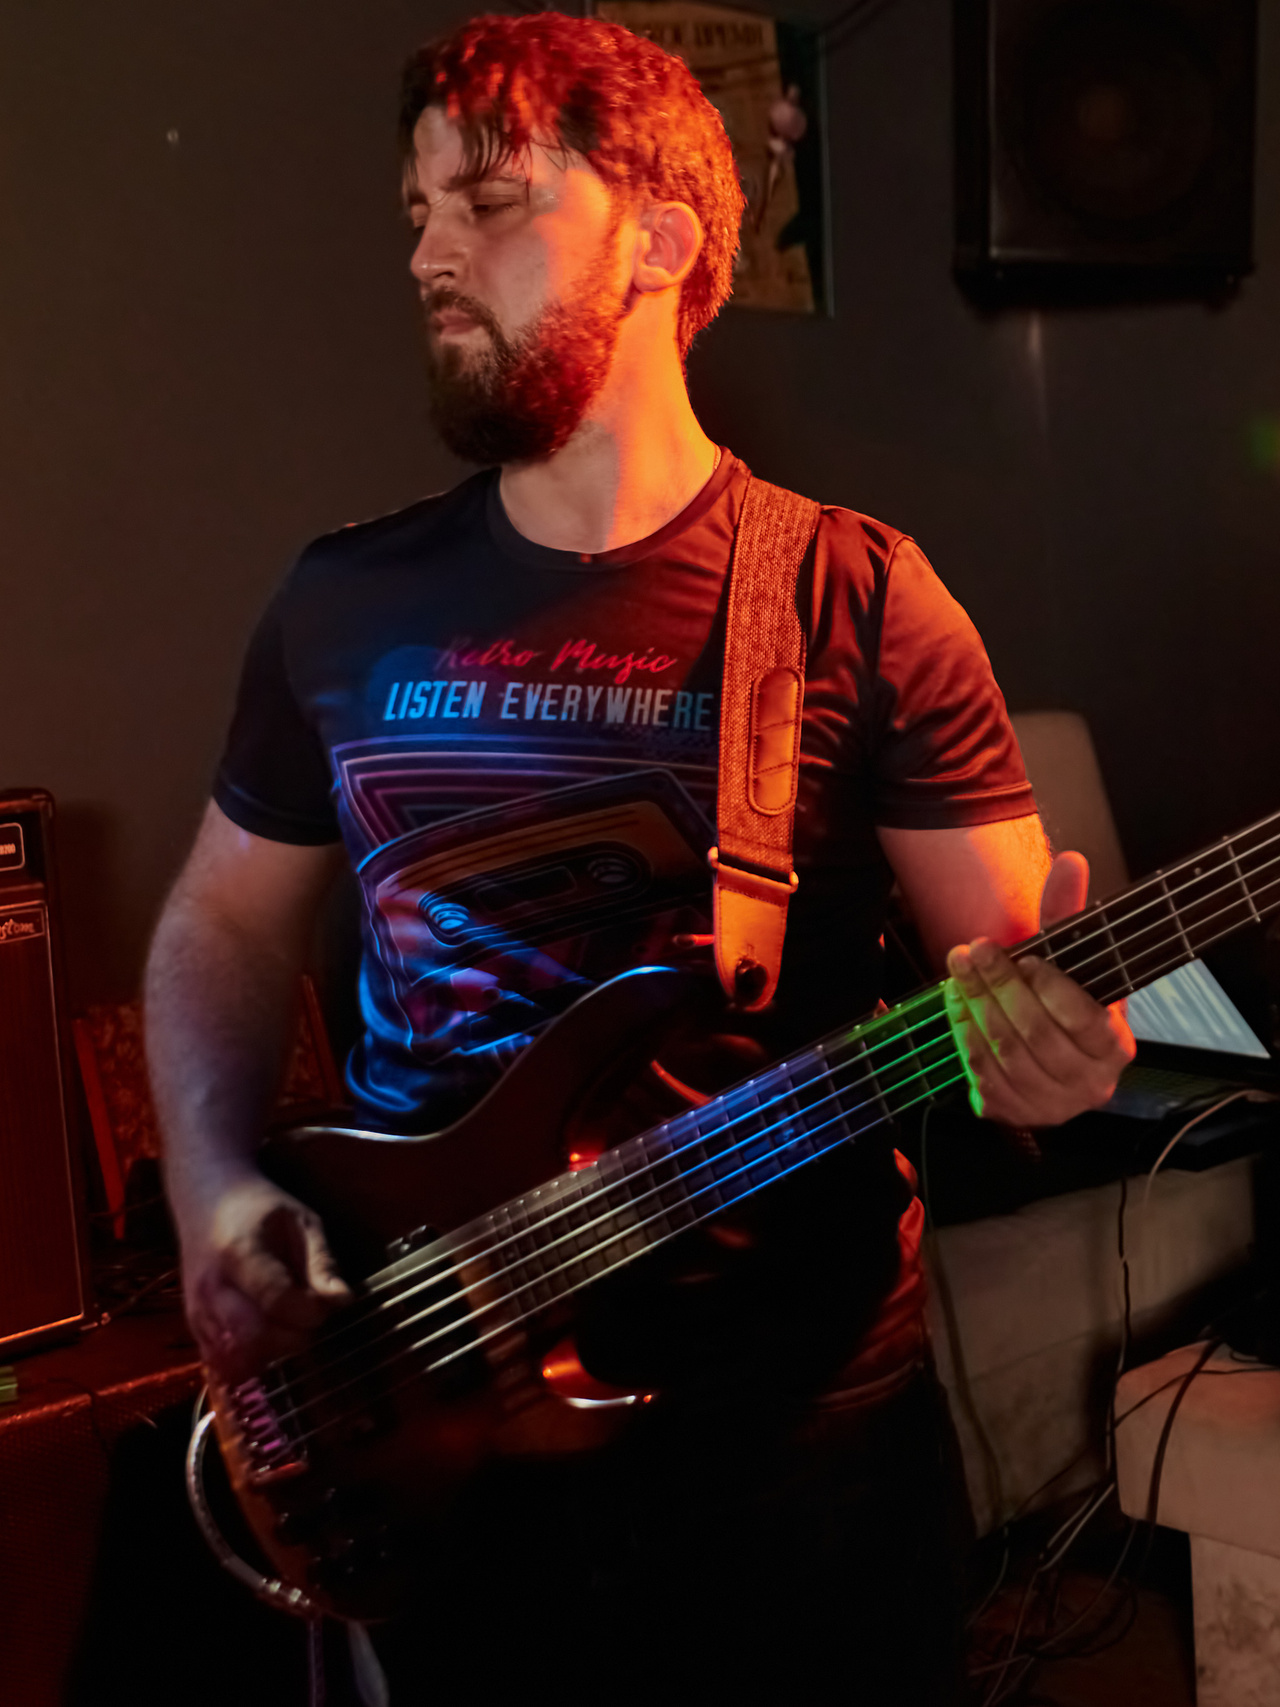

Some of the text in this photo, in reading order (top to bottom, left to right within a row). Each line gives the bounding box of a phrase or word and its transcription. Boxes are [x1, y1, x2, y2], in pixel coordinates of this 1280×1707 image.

[434, 634, 540, 670] Retro
[383, 680, 715, 731] LISTEN EVERYWHERE
